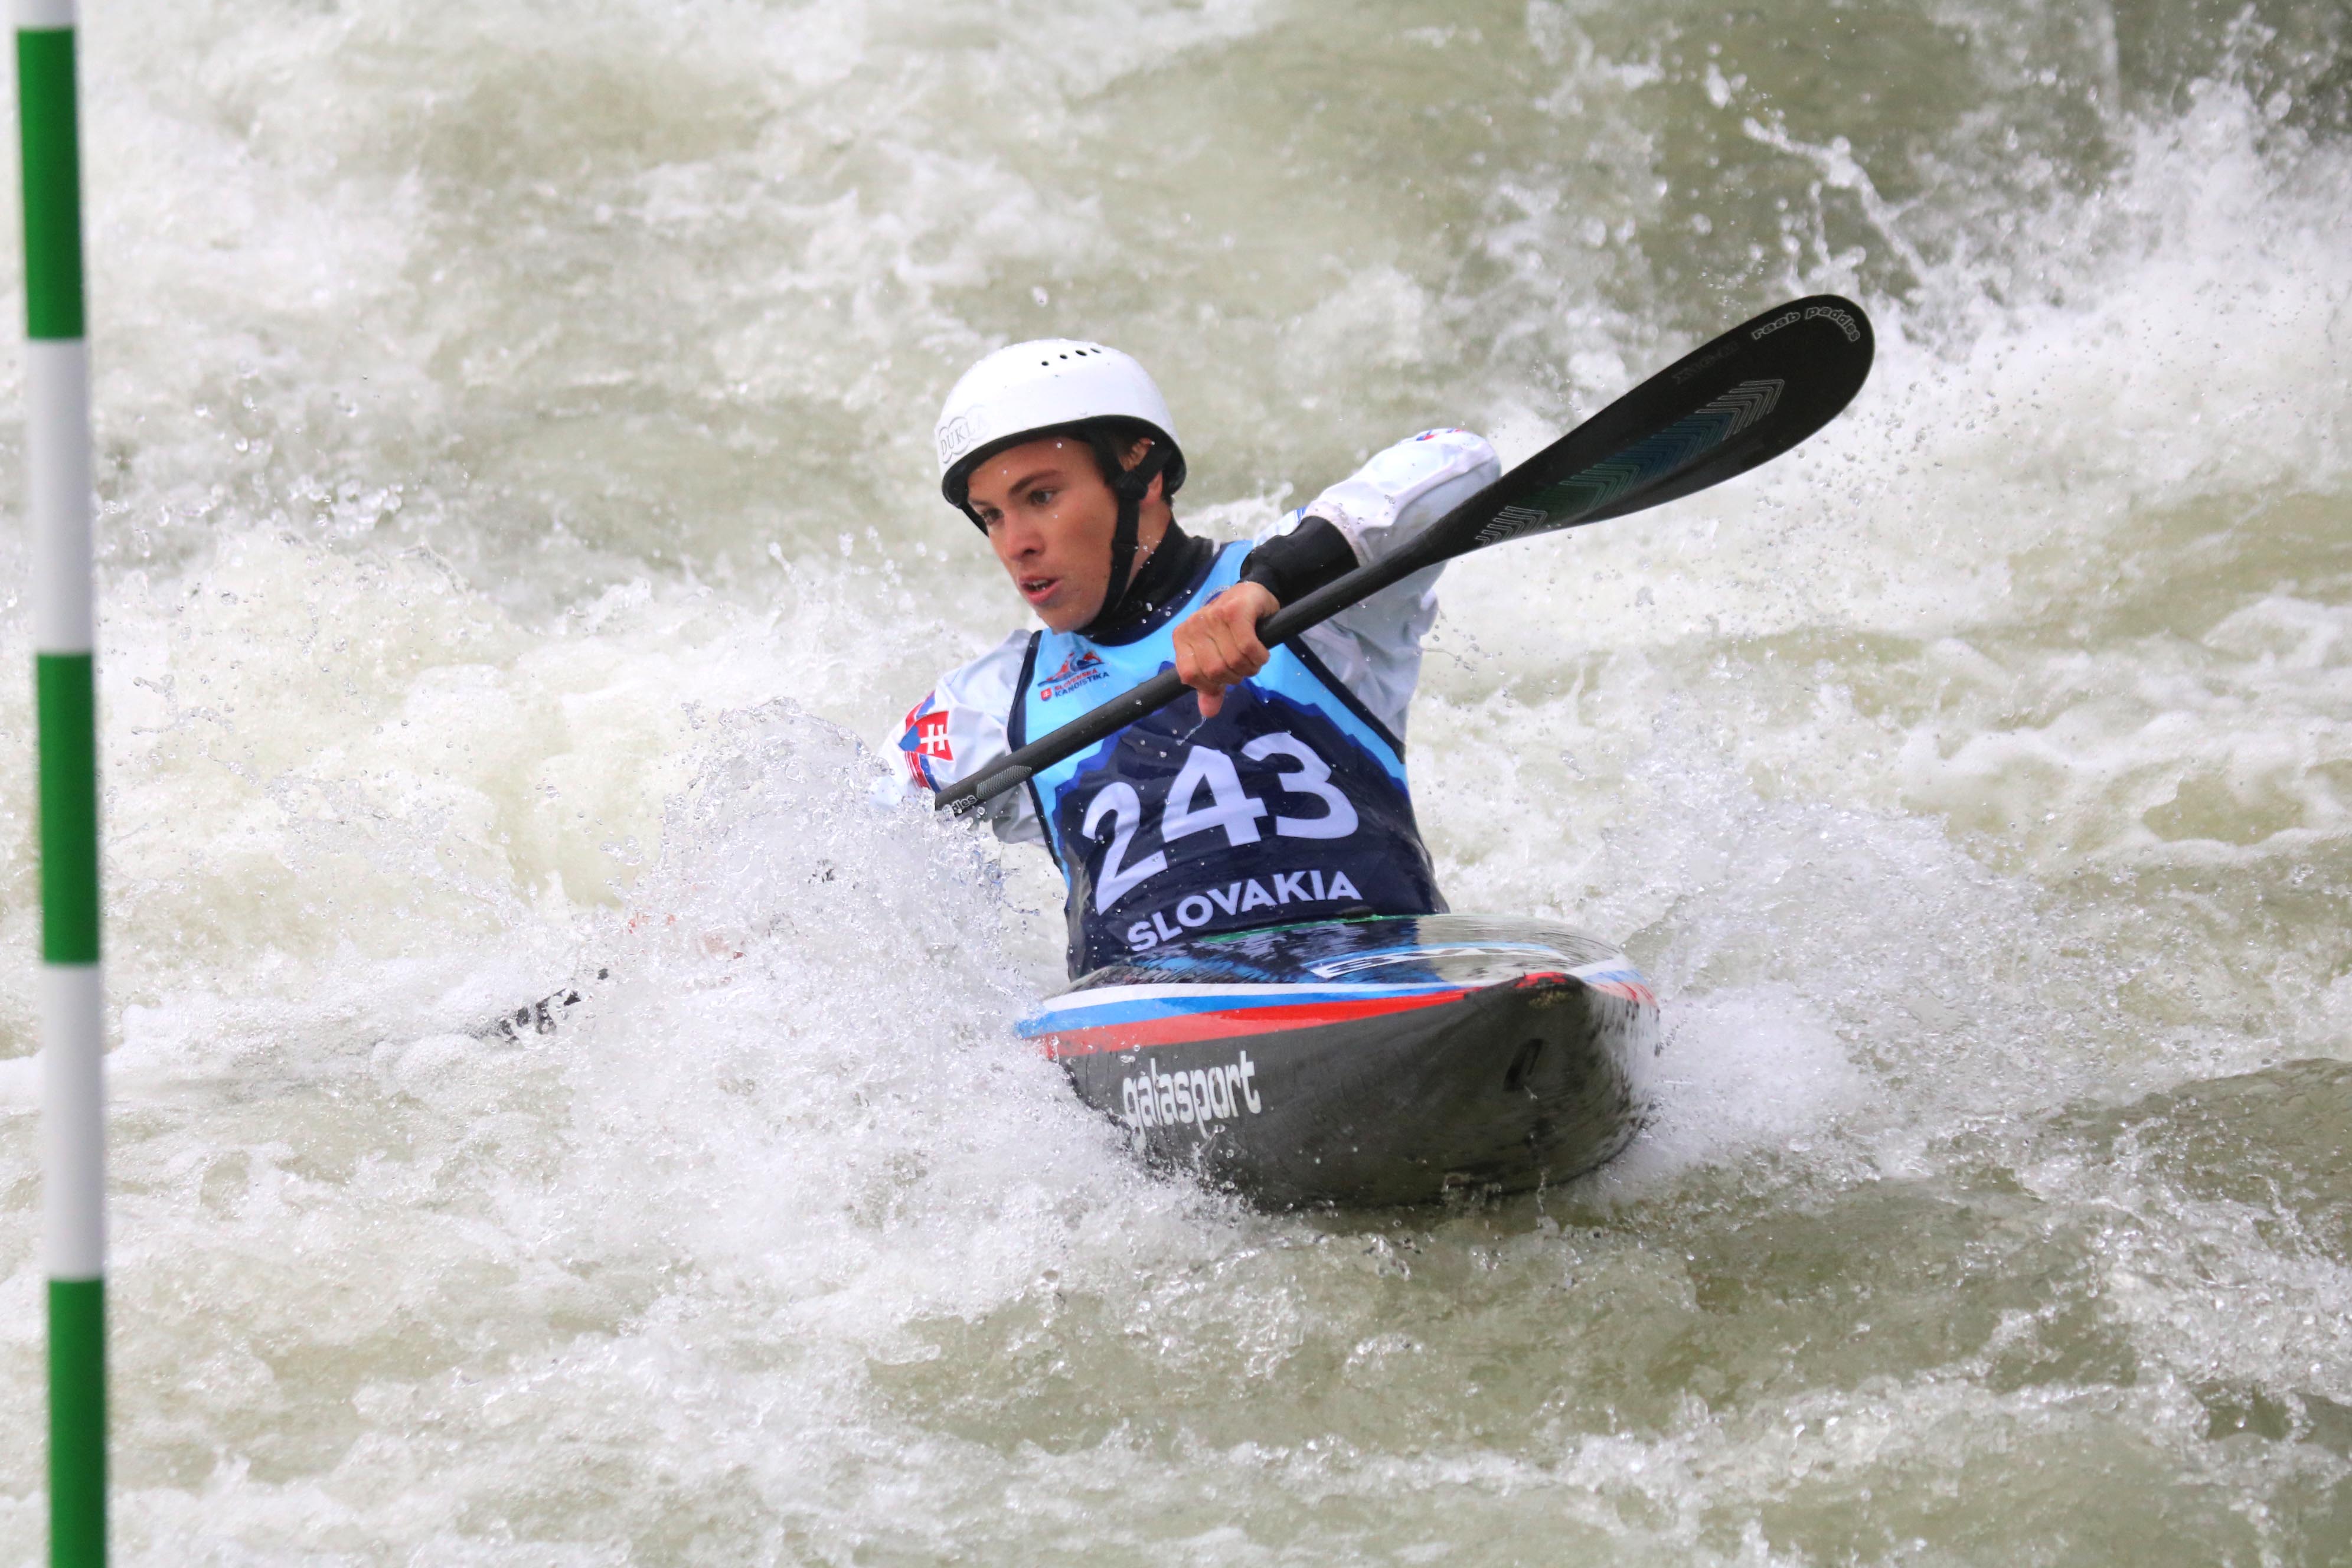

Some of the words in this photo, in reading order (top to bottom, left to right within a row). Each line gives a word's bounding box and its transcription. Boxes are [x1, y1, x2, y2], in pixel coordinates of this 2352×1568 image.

[1804, 306, 1861, 342] paddles
[1054, 668, 1097, 691] SLOVENSKA
[1055, 672, 1110, 697] KANOISTIKA
[1082, 732, 1358, 917] 243
[1127, 870, 1363, 952] SLOVAKIA
[1123, 1050, 1262, 1151] galasport
